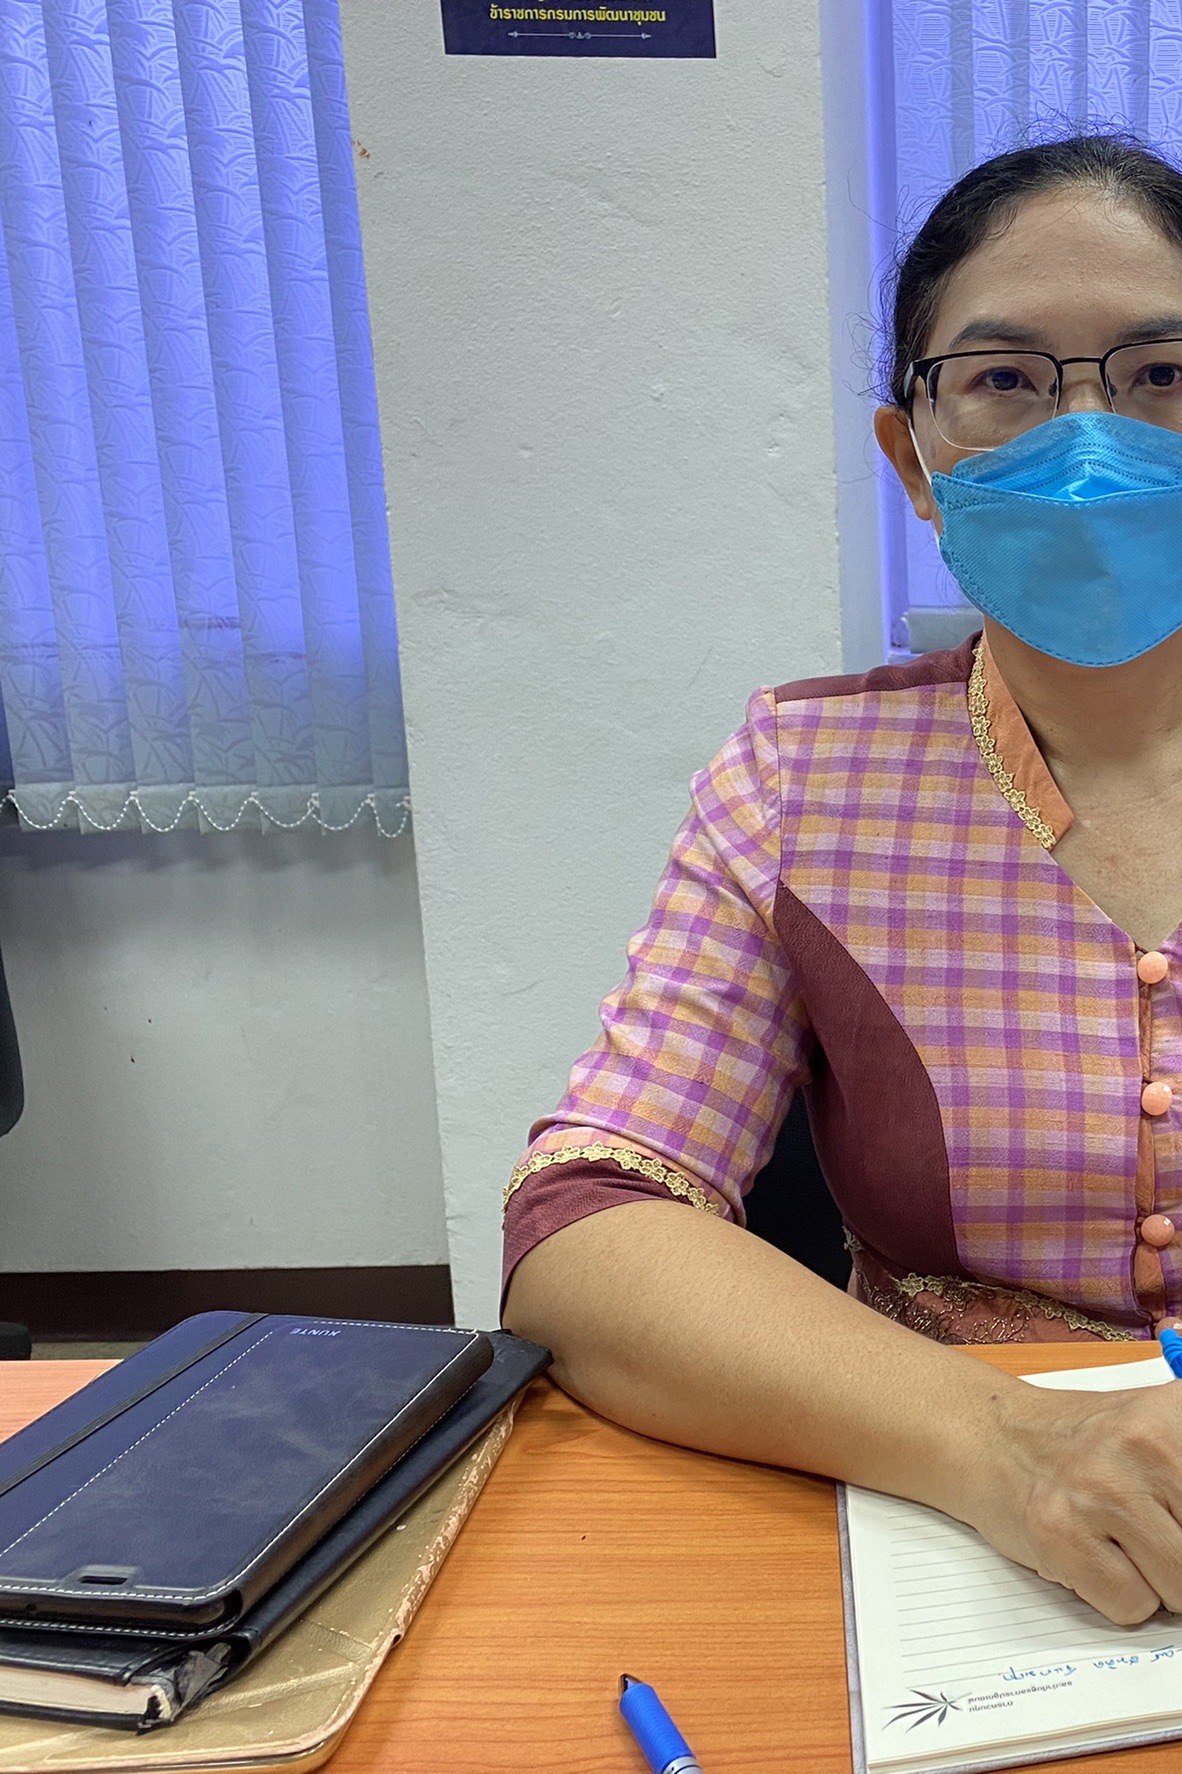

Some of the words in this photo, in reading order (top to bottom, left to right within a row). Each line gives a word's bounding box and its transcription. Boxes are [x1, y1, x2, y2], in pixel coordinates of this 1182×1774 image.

[489, 4, 666, 26] ข้าราชการกรมการพัฒนาชุมชน
